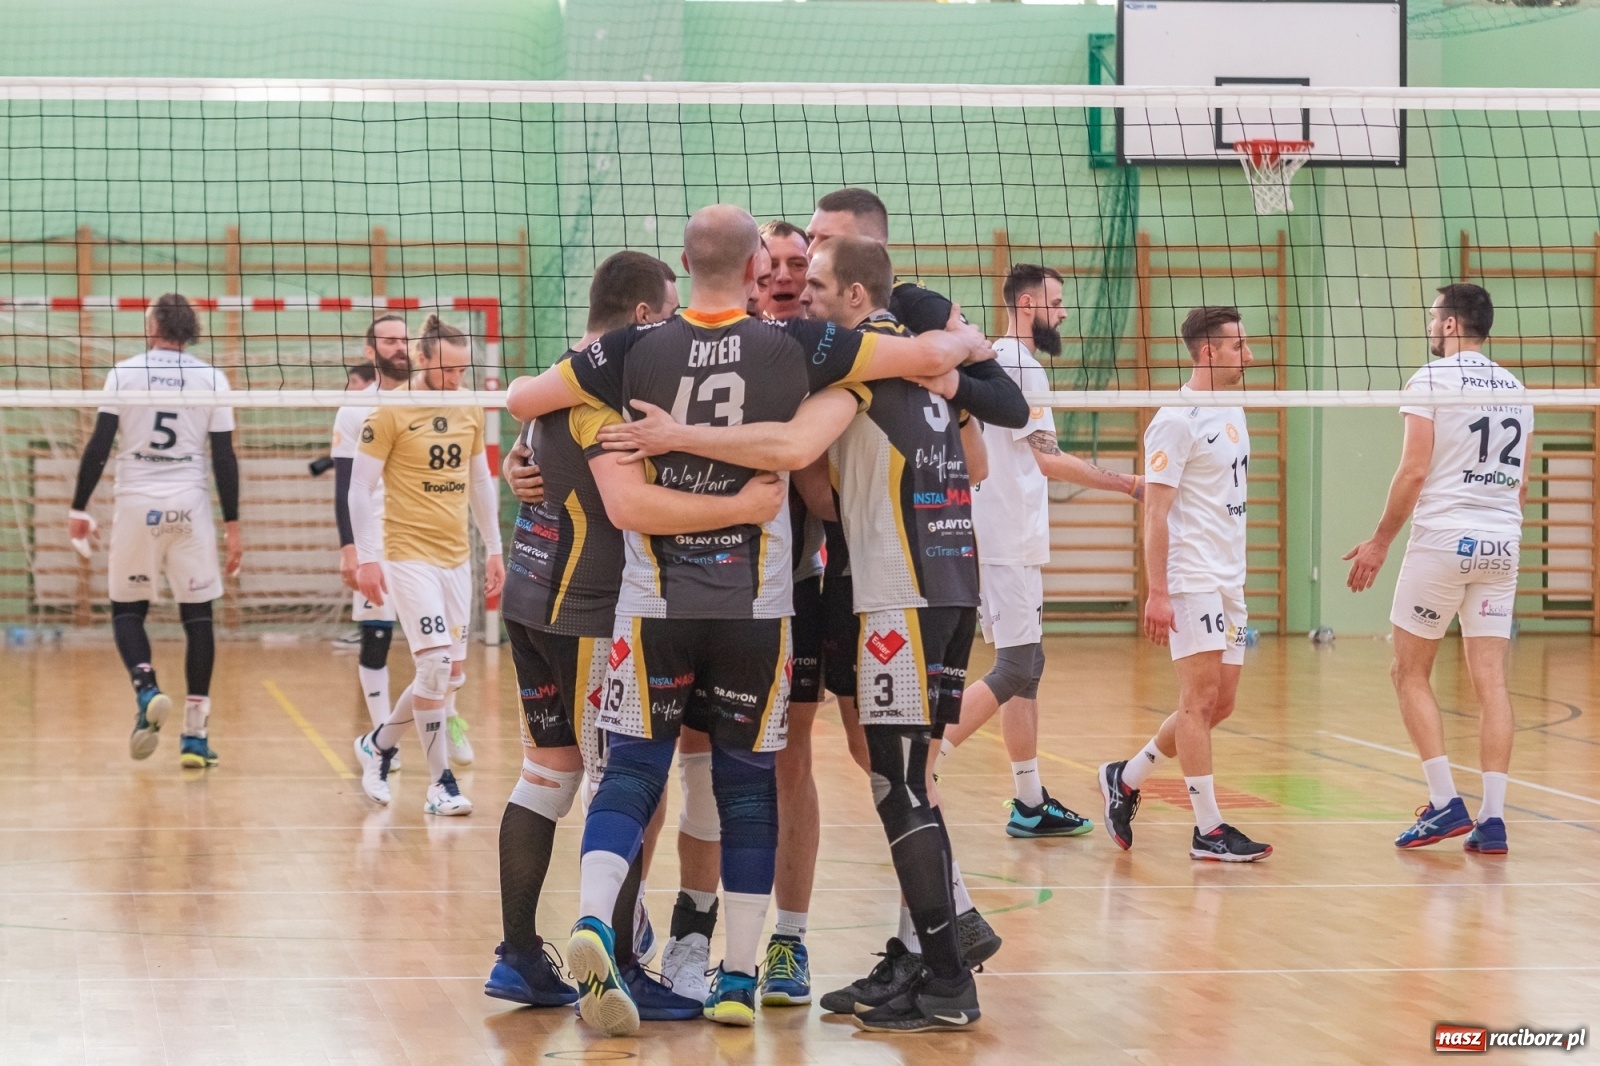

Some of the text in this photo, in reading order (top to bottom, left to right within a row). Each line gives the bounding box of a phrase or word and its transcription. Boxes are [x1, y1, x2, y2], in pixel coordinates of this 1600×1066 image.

[687, 335, 742, 368] ENTER
[1461, 376, 1518, 389] PRZYBYŁA
[670, 371, 746, 427] 13
[149, 411, 178, 451] 5
[1468, 416, 1522, 468] 12
[428, 443, 462, 471] 88
[421, 481, 466, 494] TropiDog
[165, 510, 192, 523] DK
[675, 534, 743, 546] GRAVTON
[1480, 540, 1512, 557] DK
[1460, 555, 1512, 574] glass
[420, 615, 446, 636] 88
[1200, 613, 1225, 634] 16
[871, 635, 891, 655] Enter
[603, 677, 625, 712] 13
[874, 673, 894, 708] 3
